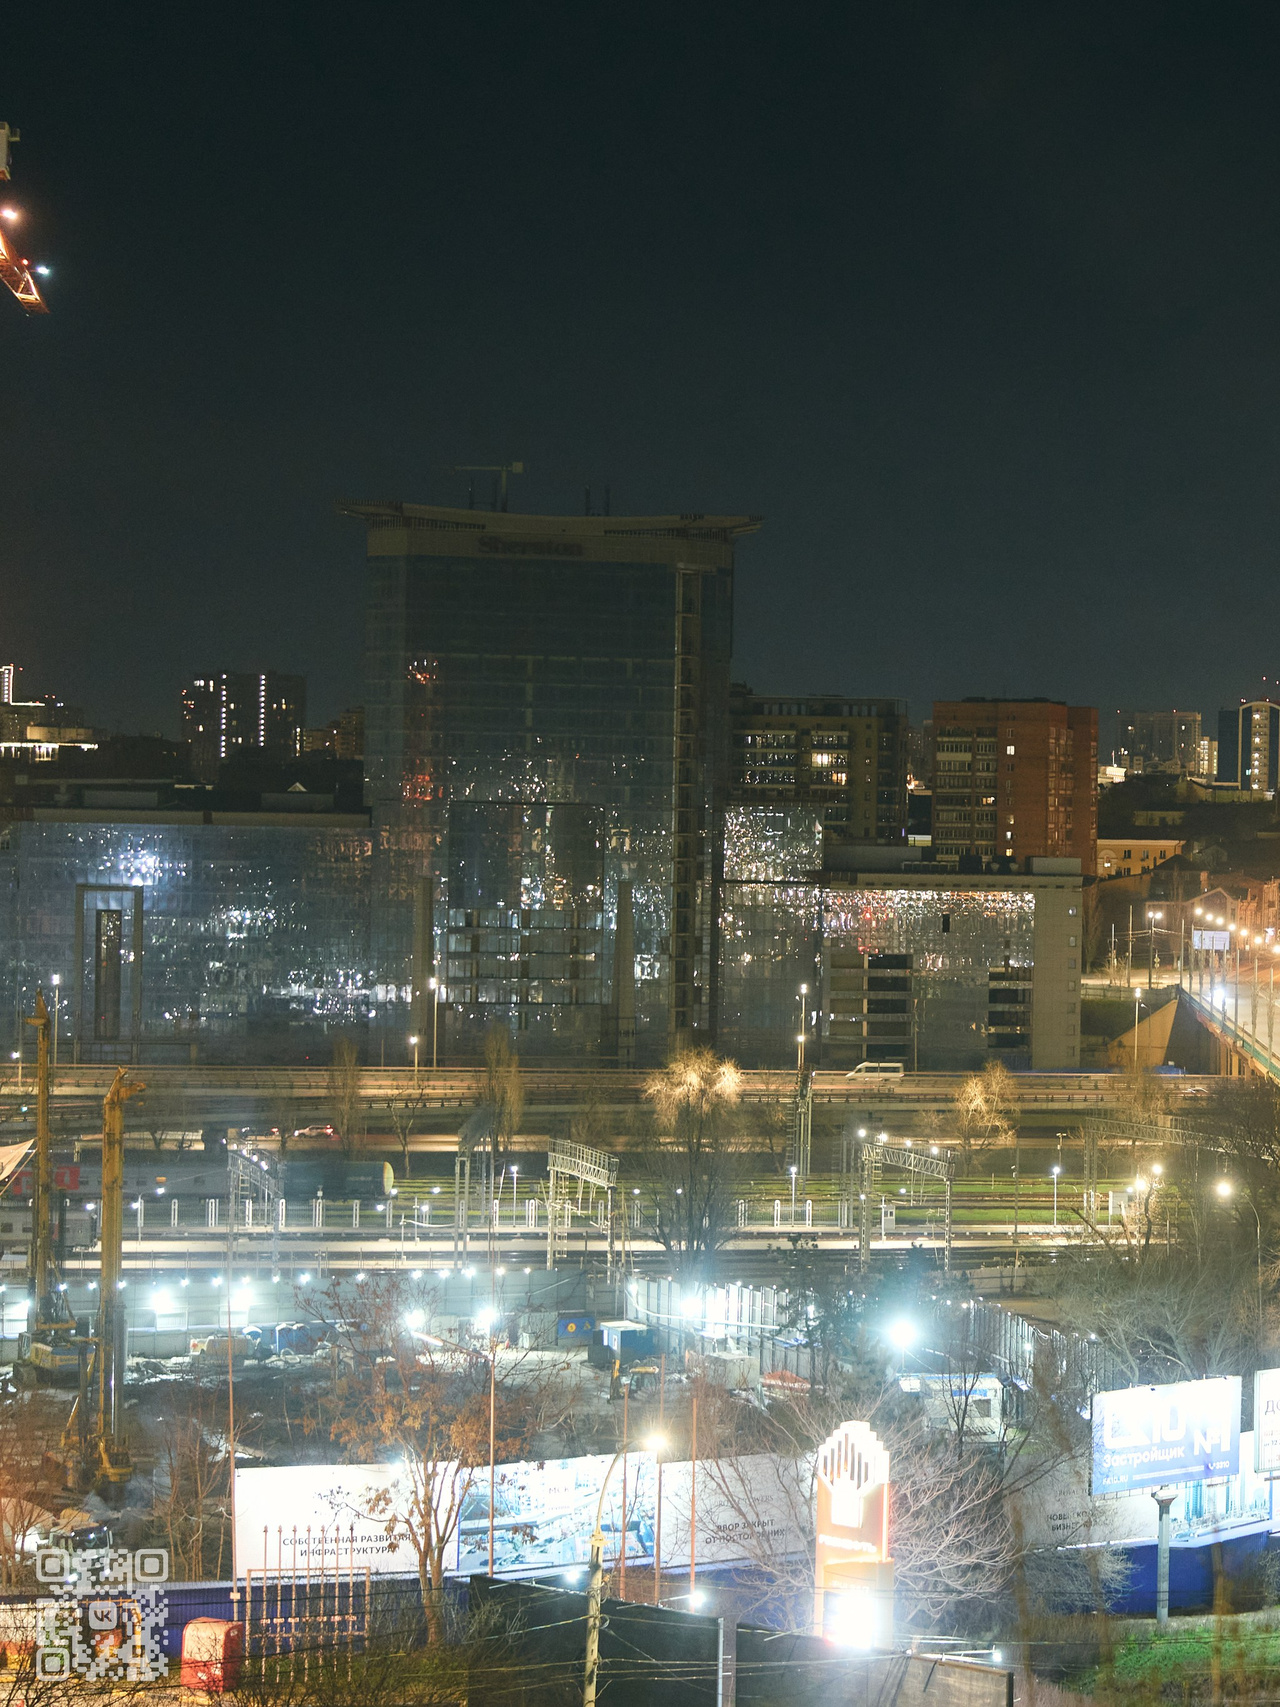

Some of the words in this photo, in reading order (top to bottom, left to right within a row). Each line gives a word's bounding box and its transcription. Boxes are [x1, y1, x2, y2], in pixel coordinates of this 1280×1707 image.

[1102, 1446, 1186, 1468] Застройщик
[717, 1522, 740, 1534] ДВОР
[741, 1518, 775, 1530] ЗКРЫТ
[282, 1535, 358, 1546] СОБСТВЕННАЯ
[720, 1528, 786, 1543] ПОСТООННИХ
[300, 1546, 395, 1557] ИНФРАСТРУКТУРА
